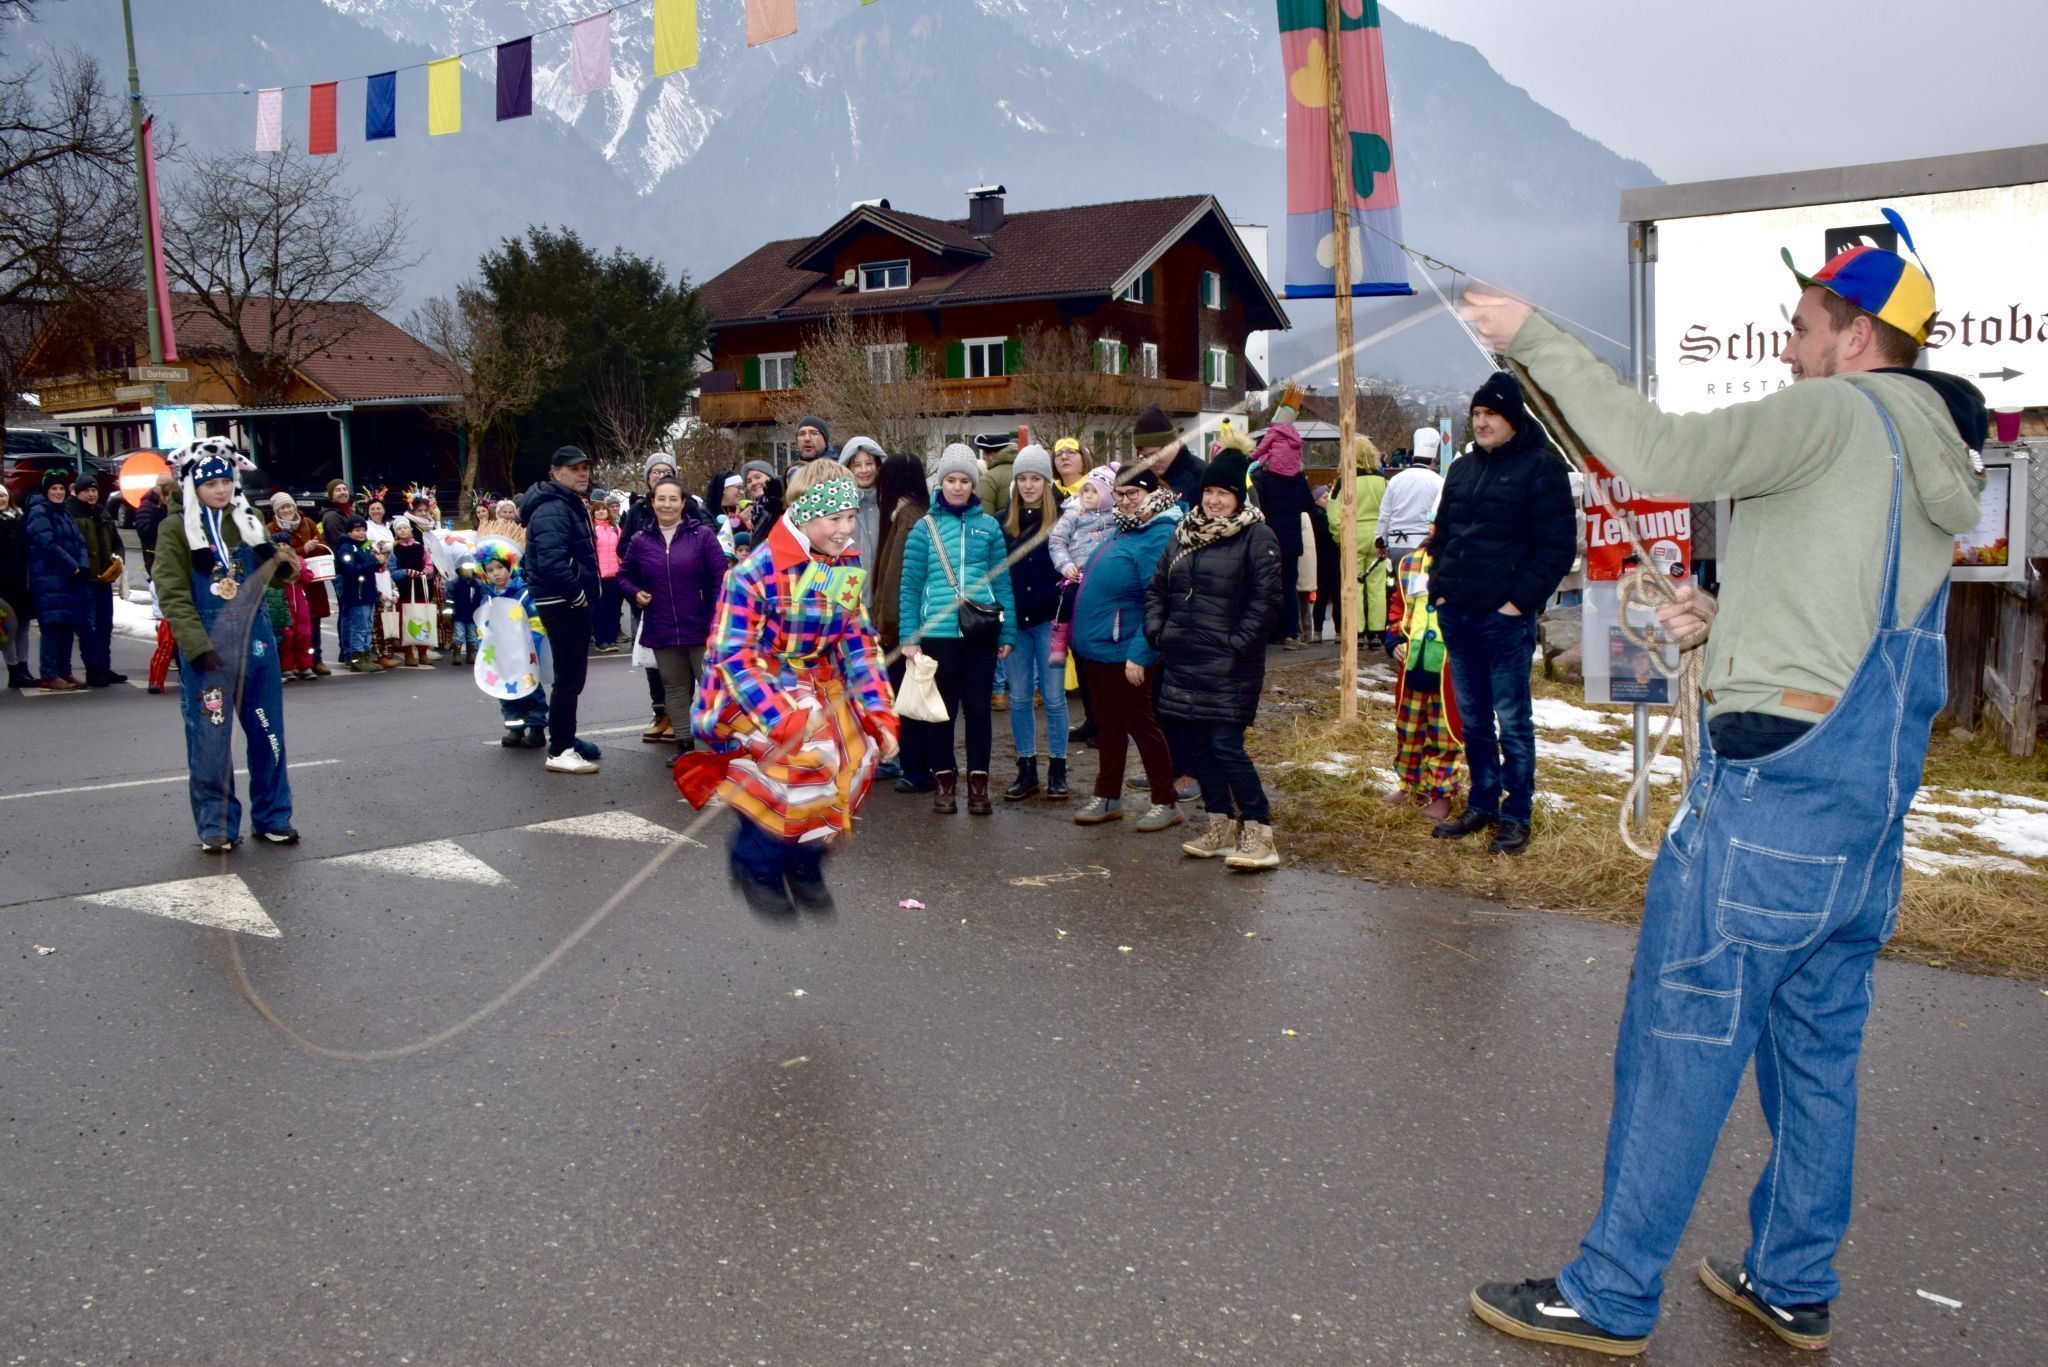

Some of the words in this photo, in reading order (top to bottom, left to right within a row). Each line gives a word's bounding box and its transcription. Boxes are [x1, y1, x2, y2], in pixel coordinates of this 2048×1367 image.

[147, 370, 181, 379] Dorfstraße
[1583, 472, 1665, 508] Kro
[1587, 508, 1691, 548] Zeitung
